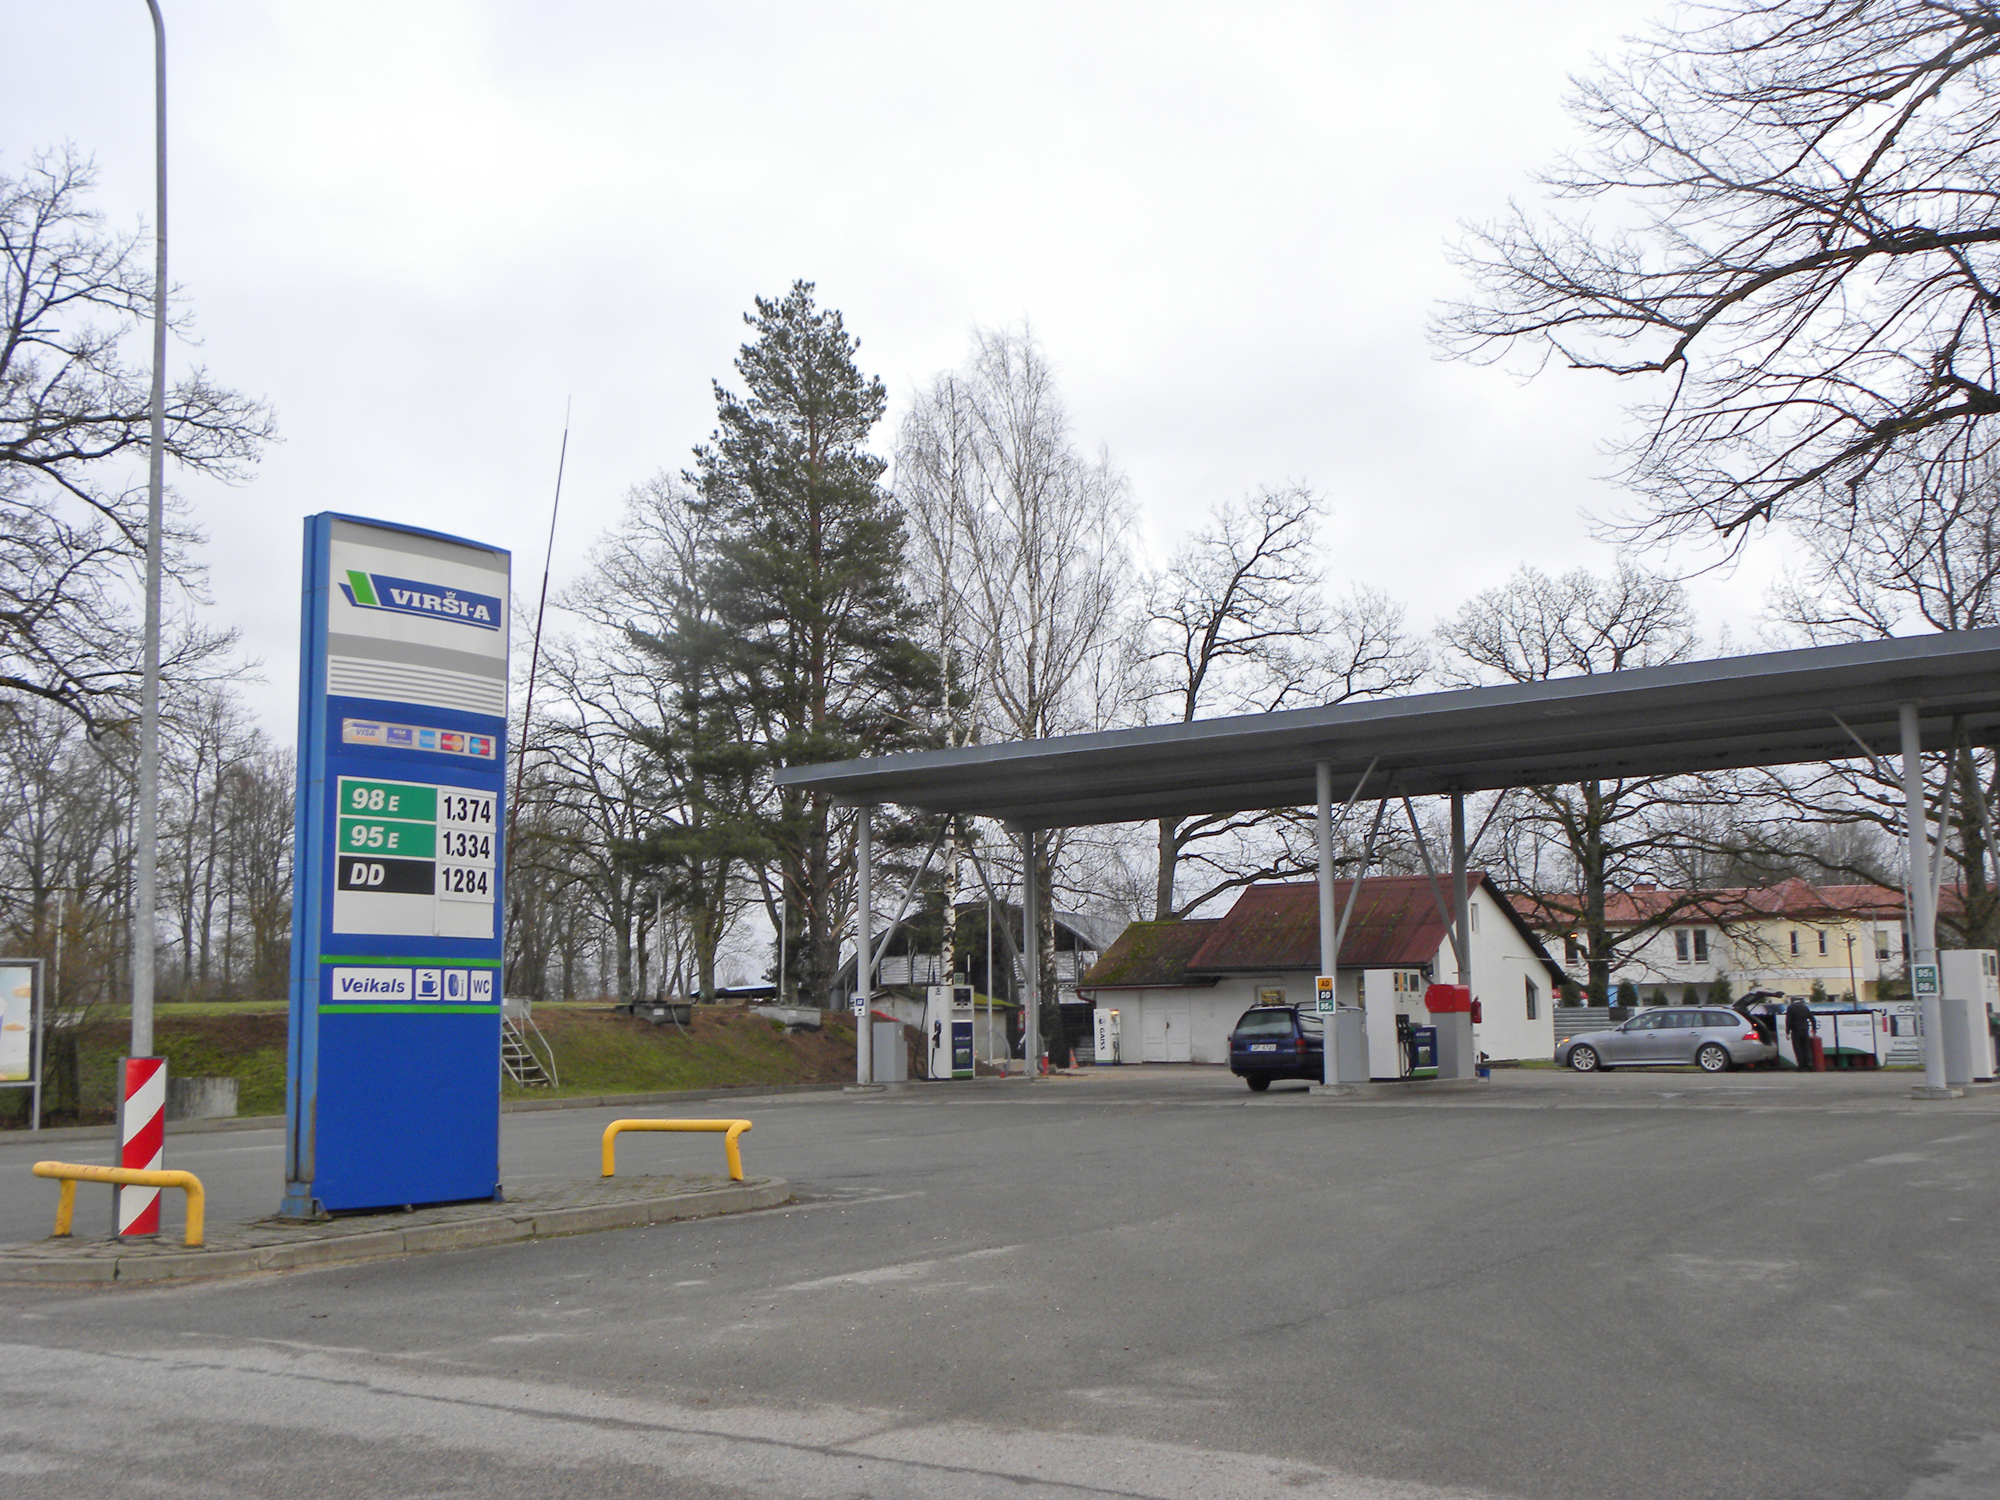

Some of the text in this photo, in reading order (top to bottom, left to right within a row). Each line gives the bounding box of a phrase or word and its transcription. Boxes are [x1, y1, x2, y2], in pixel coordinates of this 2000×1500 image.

[390, 588, 491, 621] VIRŠI-A
[355, 728, 376, 737] VISA
[351, 788, 400, 812] 98 E
[443, 796, 491, 824] 1,374
[350, 825, 400, 849] 95 E
[443, 831, 491, 859] 1,334
[349, 862, 385, 886] DD
[341, 977, 406, 993] Veikals
[473, 979, 490, 994] WC
[1320, 991, 1331, 999] DD
